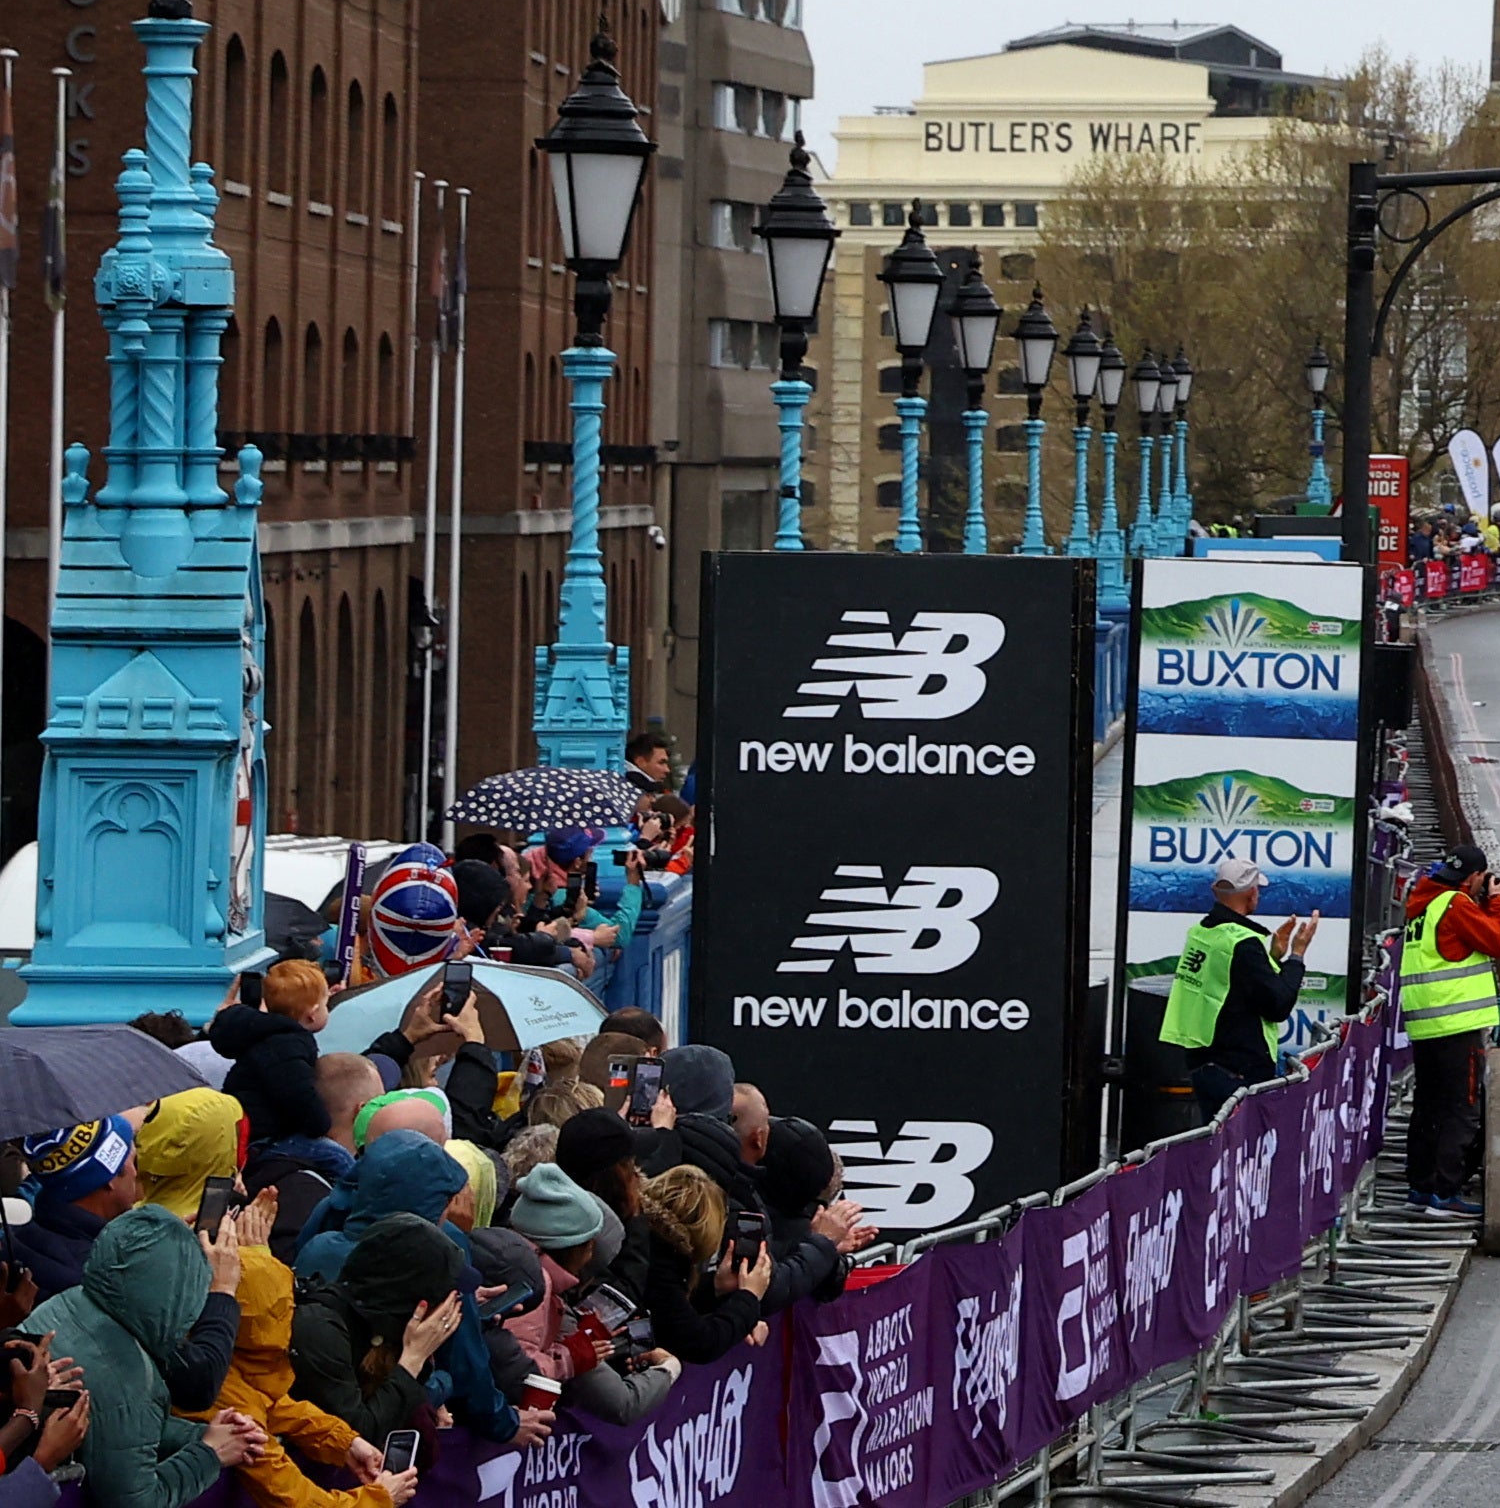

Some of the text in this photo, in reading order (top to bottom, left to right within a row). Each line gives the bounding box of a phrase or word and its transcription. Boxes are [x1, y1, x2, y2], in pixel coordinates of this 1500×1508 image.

[924, 121, 1073, 153] BUTLER'S
[1368, 471, 1400, 479] NDON
[1368, 481, 1400, 496] IDE
[1157, 648, 1341, 691] BUXTON
[739, 733, 1036, 776] new balance
[1149, 826, 1333, 868] BUXTON
[733, 988, 1030, 1030] new balance
[865, 1303, 914, 1363] ABBOTT
[866, 1353, 908, 1408] WORLD
[865, 1386, 934, 1454] MARATHON
[523, 1433, 593, 1488] ABBOTT
[864, 1443, 914, 1502] MAJORS
